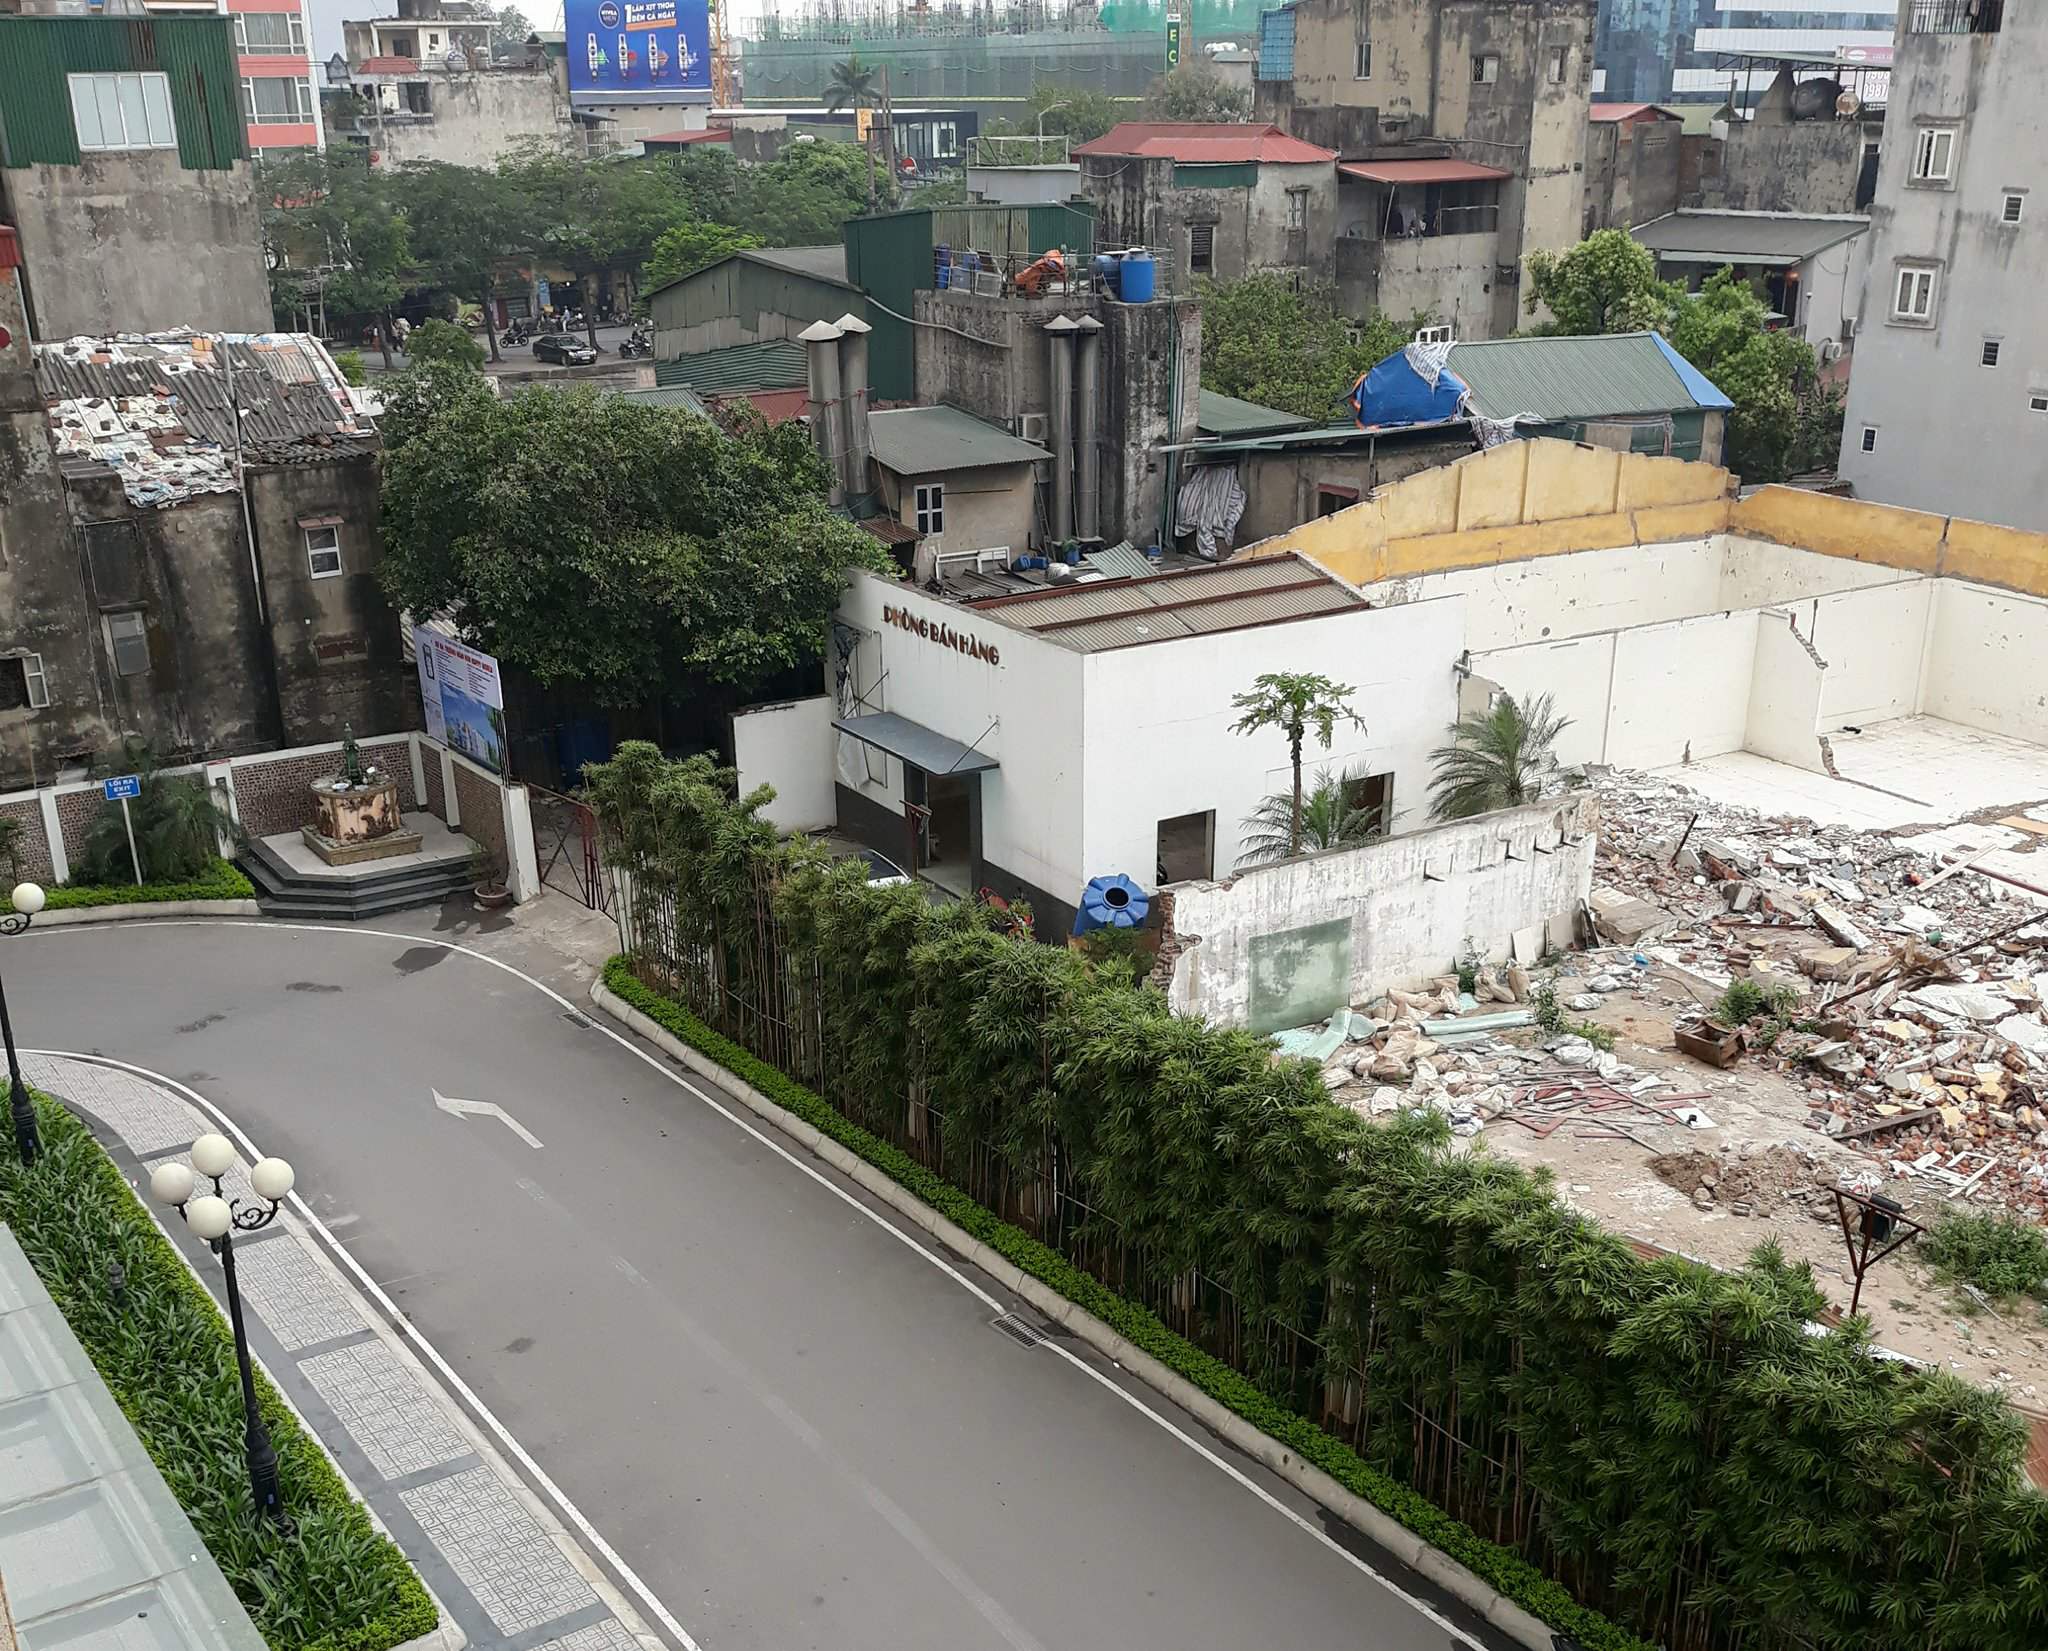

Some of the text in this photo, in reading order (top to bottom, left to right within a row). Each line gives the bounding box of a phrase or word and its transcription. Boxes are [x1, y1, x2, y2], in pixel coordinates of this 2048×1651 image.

[624, 4, 632, 23] 1
[883, 605, 999, 666] PHÒNG BÁN HÀNG
